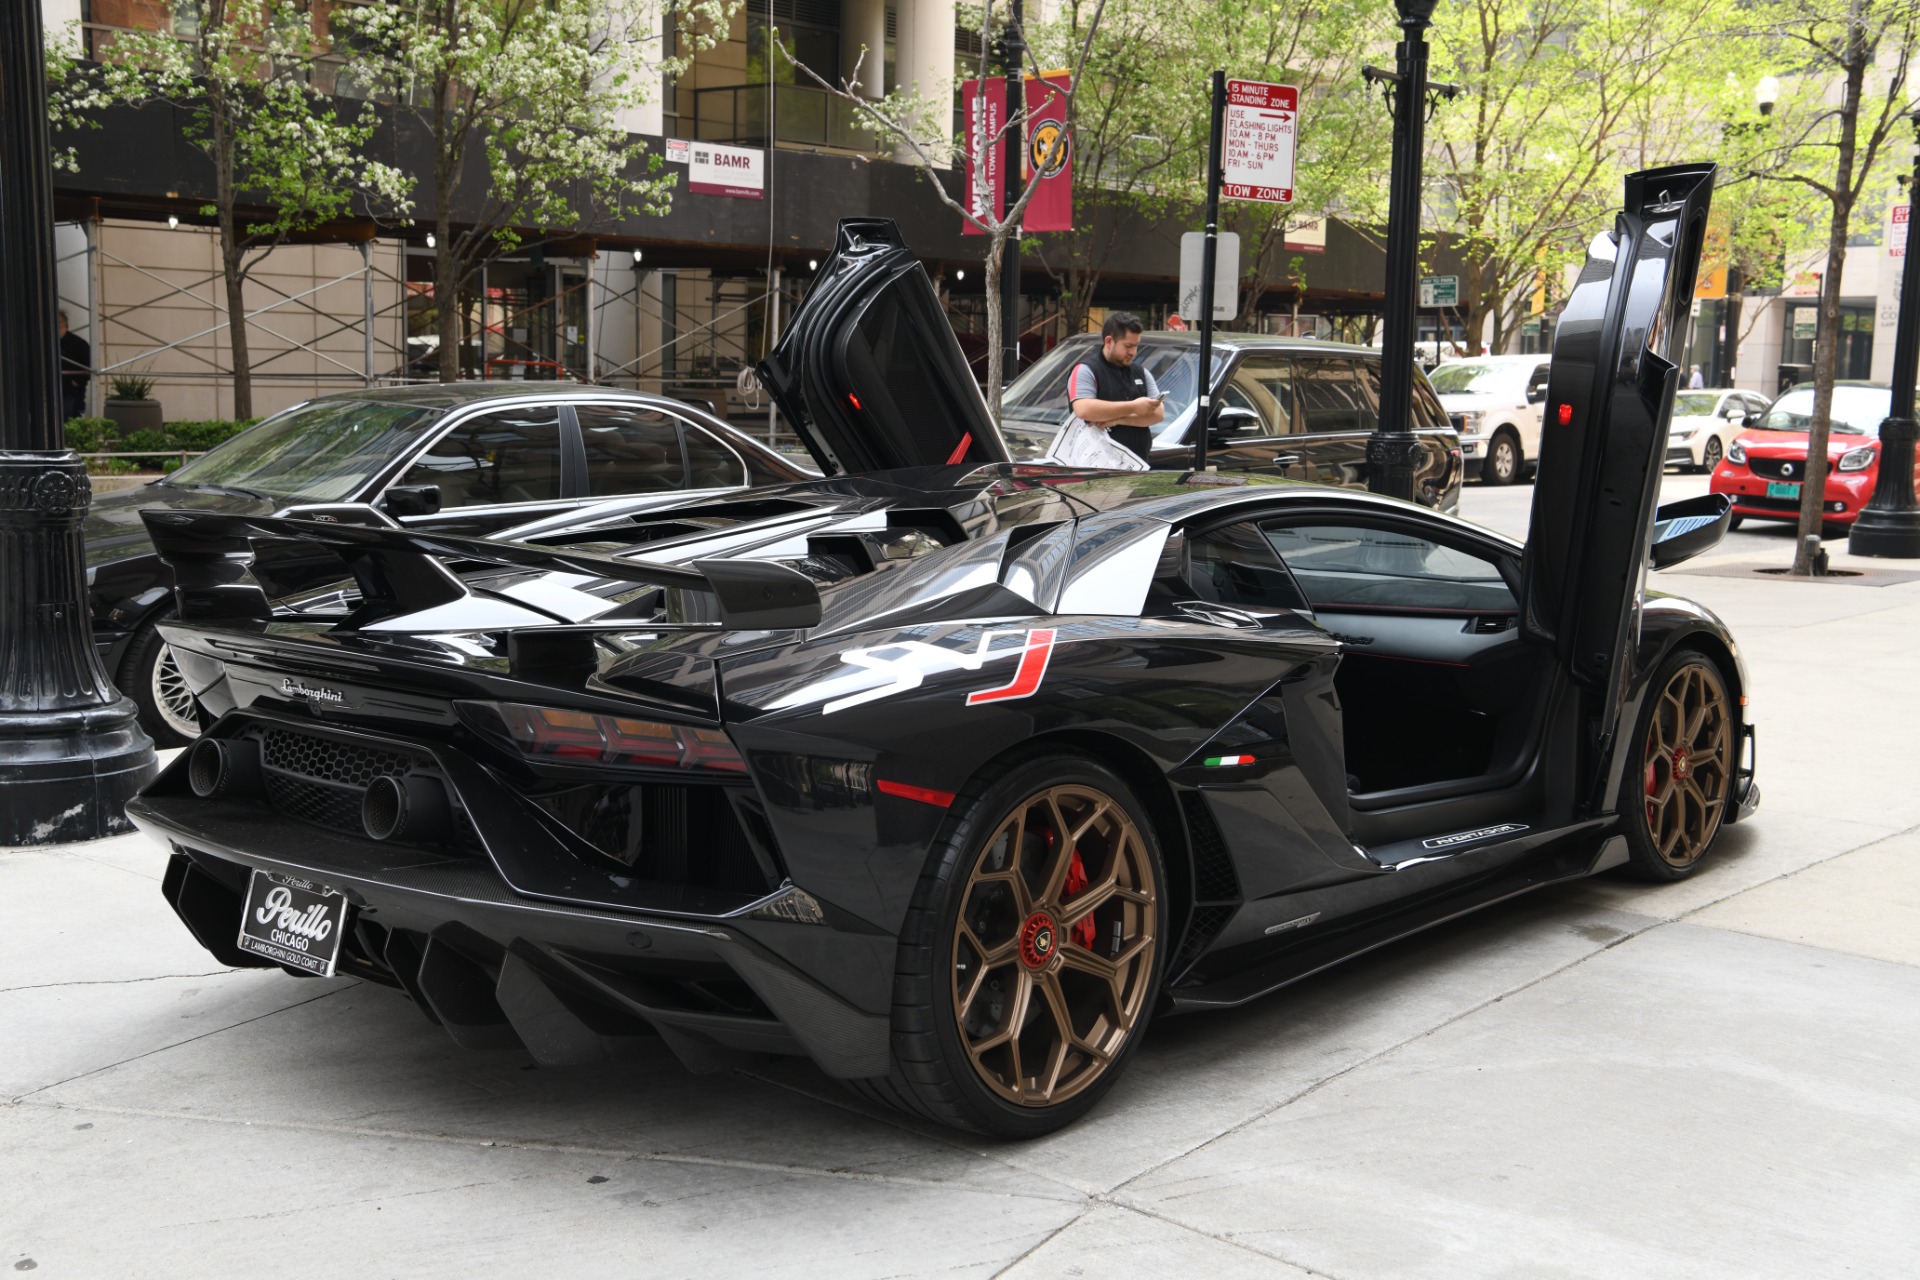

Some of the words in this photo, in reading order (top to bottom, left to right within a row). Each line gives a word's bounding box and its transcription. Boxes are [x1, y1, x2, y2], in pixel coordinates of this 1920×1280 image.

[1232, 84, 1239, 92] 15
[1242, 85, 1269, 96] MINUTE
[1231, 94, 1266, 106] STANDING
[1270, 98, 1290, 108] ZONE
[988, 102, 997, 140] CAMPUS
[1230, 110, 1245, 118] USE
[1229, 120, 1265, 131] FLASHING
[1267, 123, 1292, 134] LIGHTS
[1265, 133, 1276, 141] PM
[1228, 139, 1245, 148] MON
[1254, 141, 1279, 152] THURS
[714, 153, 750, 169] BAMR
[972, 96, 987, 218] WEOME
[988, 144, 996, 176] TOWER
[1227, 159, 1240, 168] FRI
[1247, 161, 1263, 170] SUN
[1226, 184, 1251, 197] TOW
[1256, 187, 1287, 200] ZONE
[822, 628, 1057, 715] SVJ
[280, 678, 343, 702] Lamborghini
[282, 875, 314, 890] Perillo
[256, 886, 332, 942] Perillo
[271, 929, 309, 951] CHICAGO
[251, 940, 286, 958] LAMBORGHINI
[286, 952, 301, 964] GOLD
[300, 956, 318, 969] COAST
